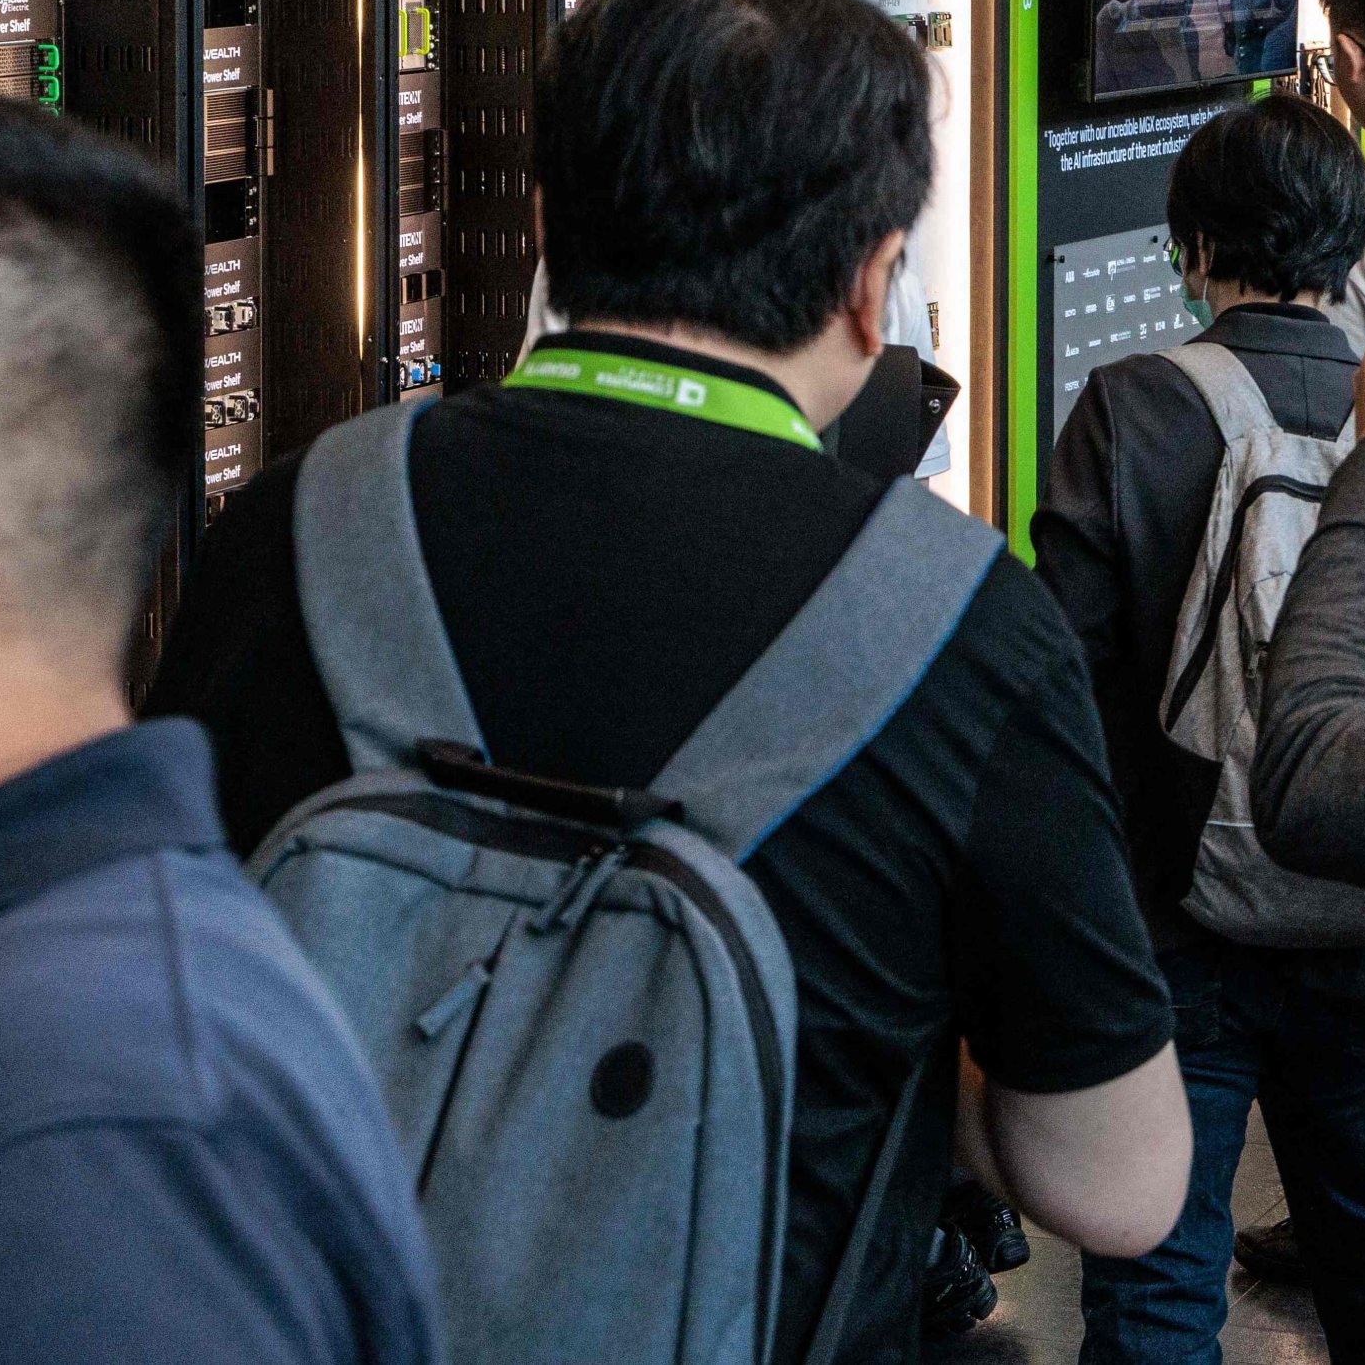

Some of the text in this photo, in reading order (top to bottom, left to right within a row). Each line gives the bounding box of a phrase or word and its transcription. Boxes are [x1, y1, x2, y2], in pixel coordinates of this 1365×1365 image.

[7, 4, 30, 12] Electric
[10, 18, 31, 32] Shelf
[223, 67, 241, 81] Shelf
[406, 111, 423, 125] Shelf
[1080, 125, 1095, 143] with
[1096, 126, 1107, 140] our
[1107, 118, 1138, 139] incredible
[1139, 115, 1155, 133] MGX
[1155, 112, 1190, 134] ecosystem,
[1060, 139, 1162, 171] the AI infrastructure of the next
[408, 251, 424, 267] Shelf
[223, 280, 241, 295] Shelf
[410, 338, 425, 352] Shelf
[223, 372, 241, 387] Shelf
[223, 464, 241, 480] Shelf
